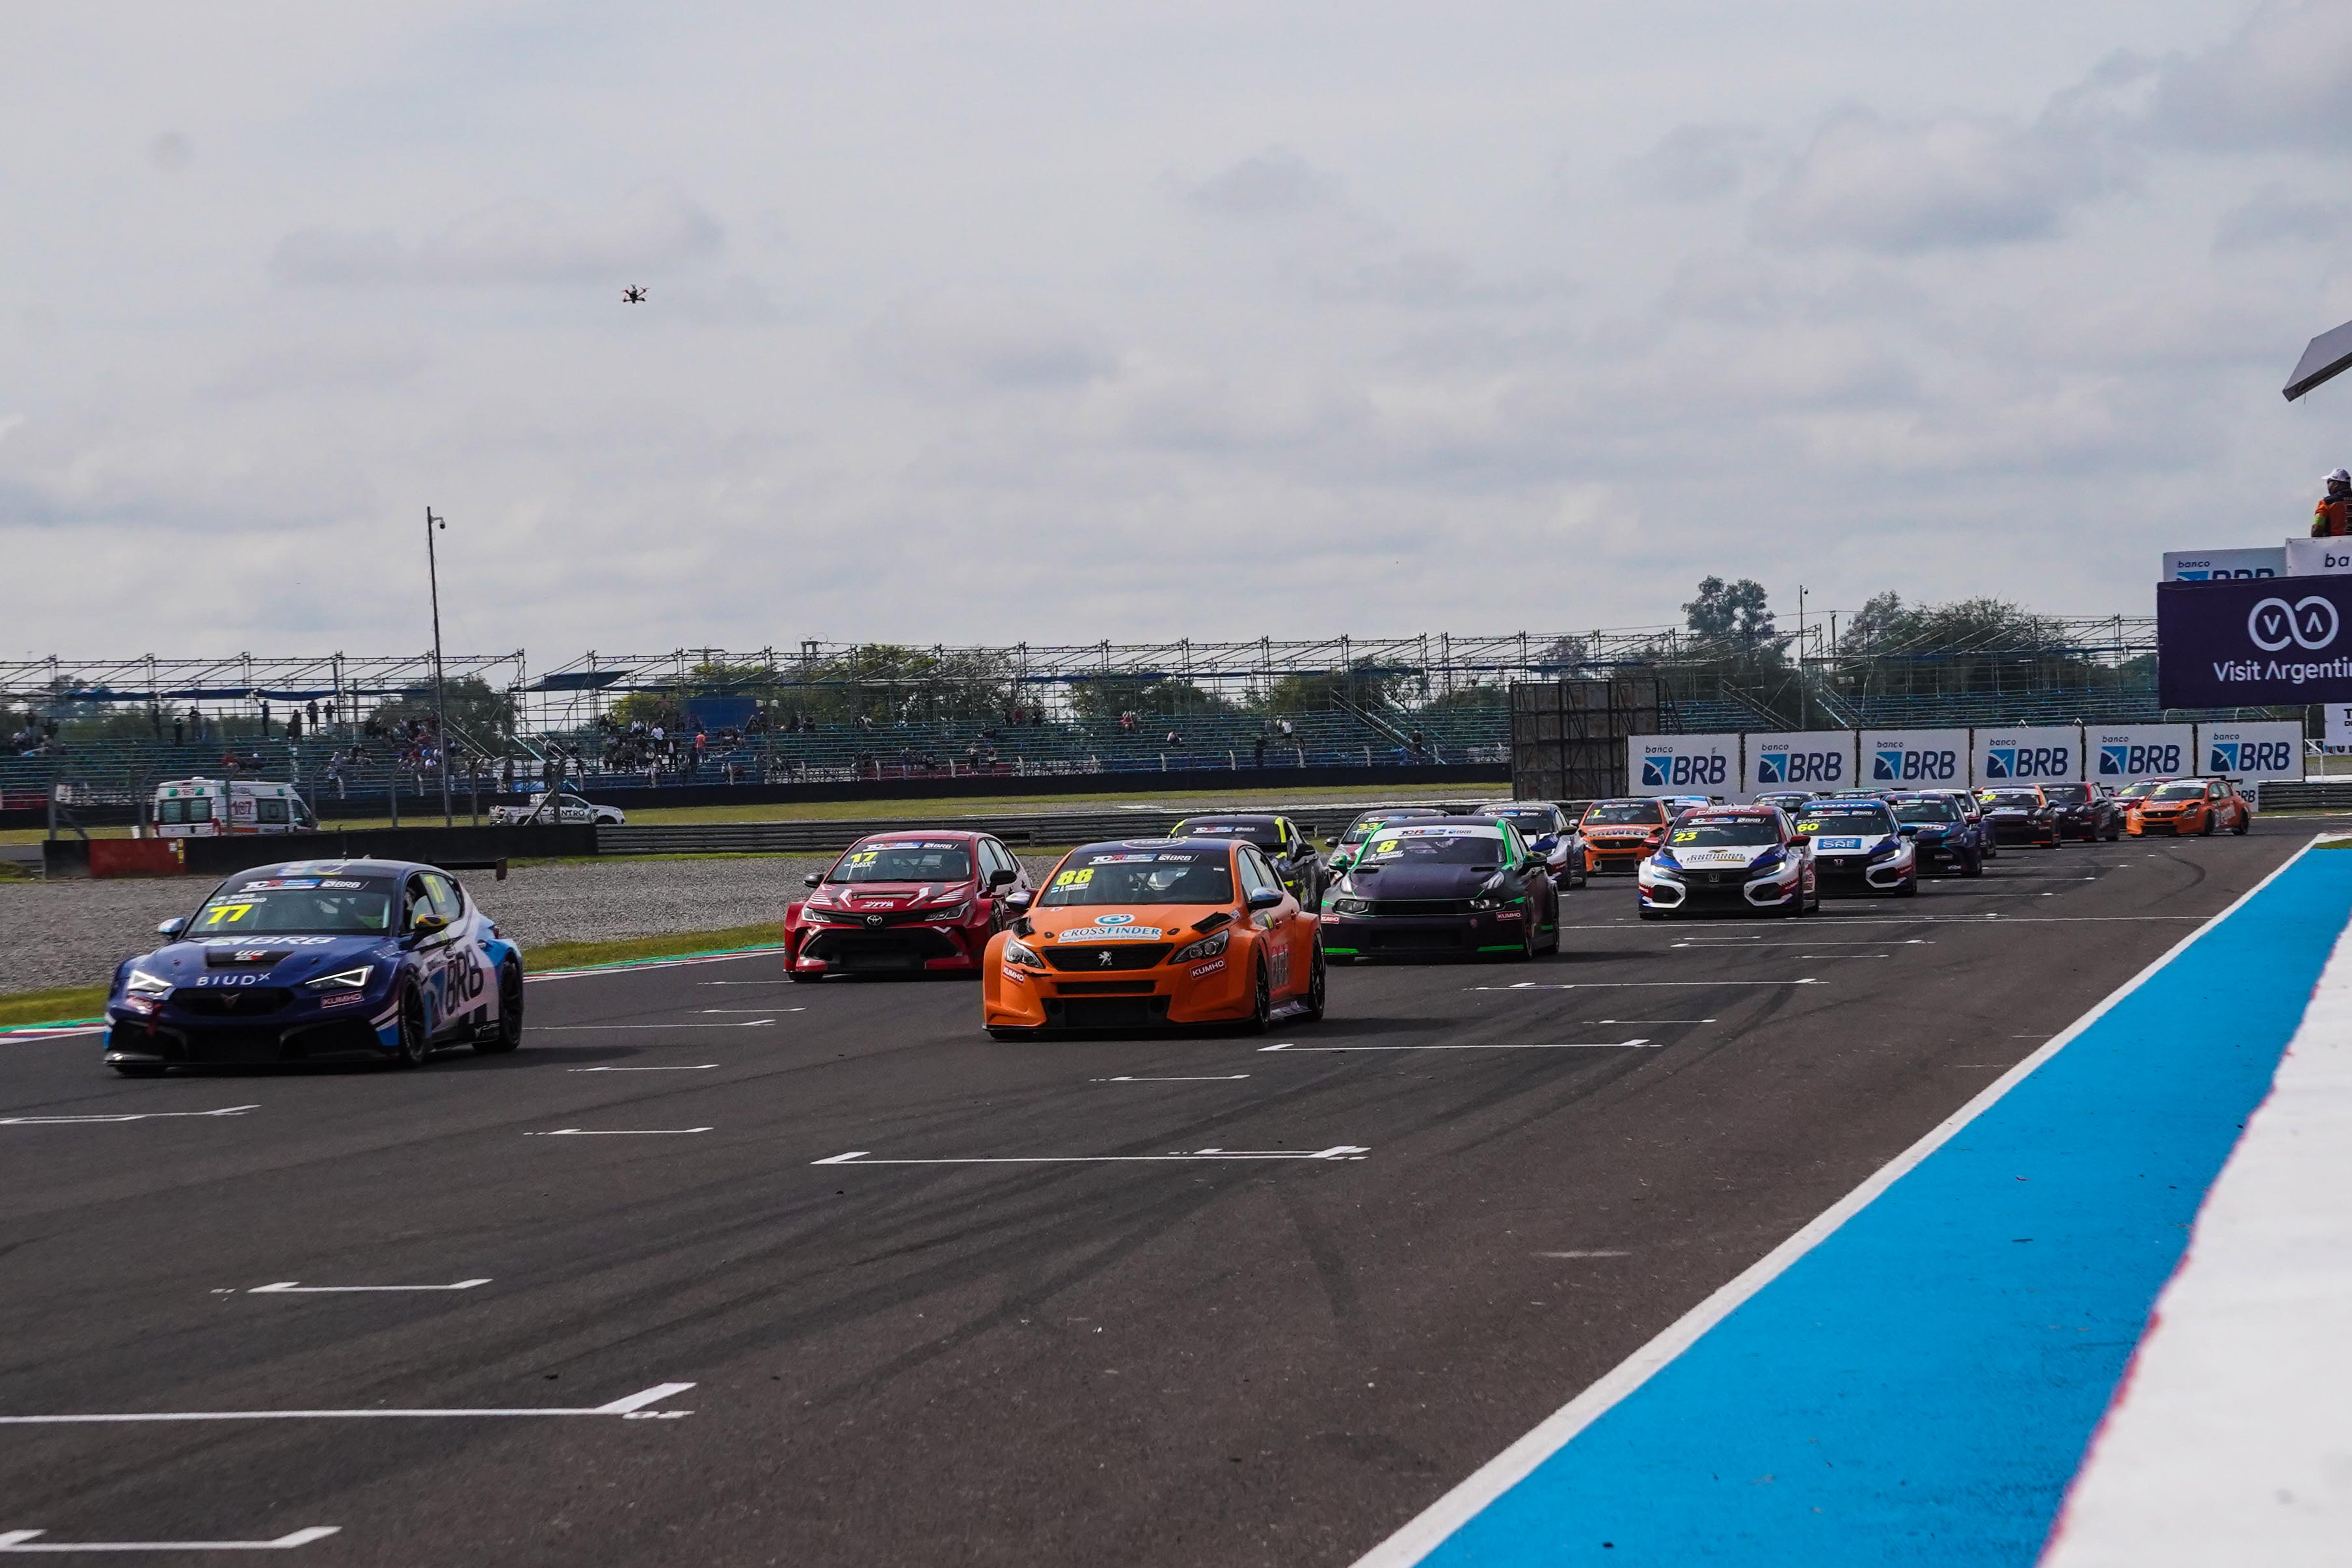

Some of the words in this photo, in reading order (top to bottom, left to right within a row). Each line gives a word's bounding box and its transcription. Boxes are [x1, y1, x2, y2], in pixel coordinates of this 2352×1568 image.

[2325, 553, 2350, 568] ba
[2213, 660, 2261, 681] Visit
[2265, 656, 2352, 684] Argenti
[1645, 745, 1673, 753] banco
[2239, 742, 2290, 771] BRB
[1789, 751, 1843, 781] BRB
[1903, 750, 1956, 780] BRB
[2017, 747, 2068, 777] BRB
[2129, 744, 2181, 774] BRB
[1673, 755, 1727, 785] BRB
[2236, 790, 2256, 802] RB
[1797, 822, 1819, 832] 60
[1673, 832, 1697, 843] 23
[1377, 841, 1398, 852] 8
[850, 852, 878, 863] 17
[246, 880, 284, 889] TCR
[1057, 869, 1095, 885] 88
[207, 904, 253, 925] 77
[1062, 927, 1160, 938] CROSSFINDER
[1003, 967, 1024, 982] KUMHO
[1192, 960, 1224, 977] KUMHO
[446, 944, 483, 1016] BRB
[323, 993, 362, 1006] KUMHO
